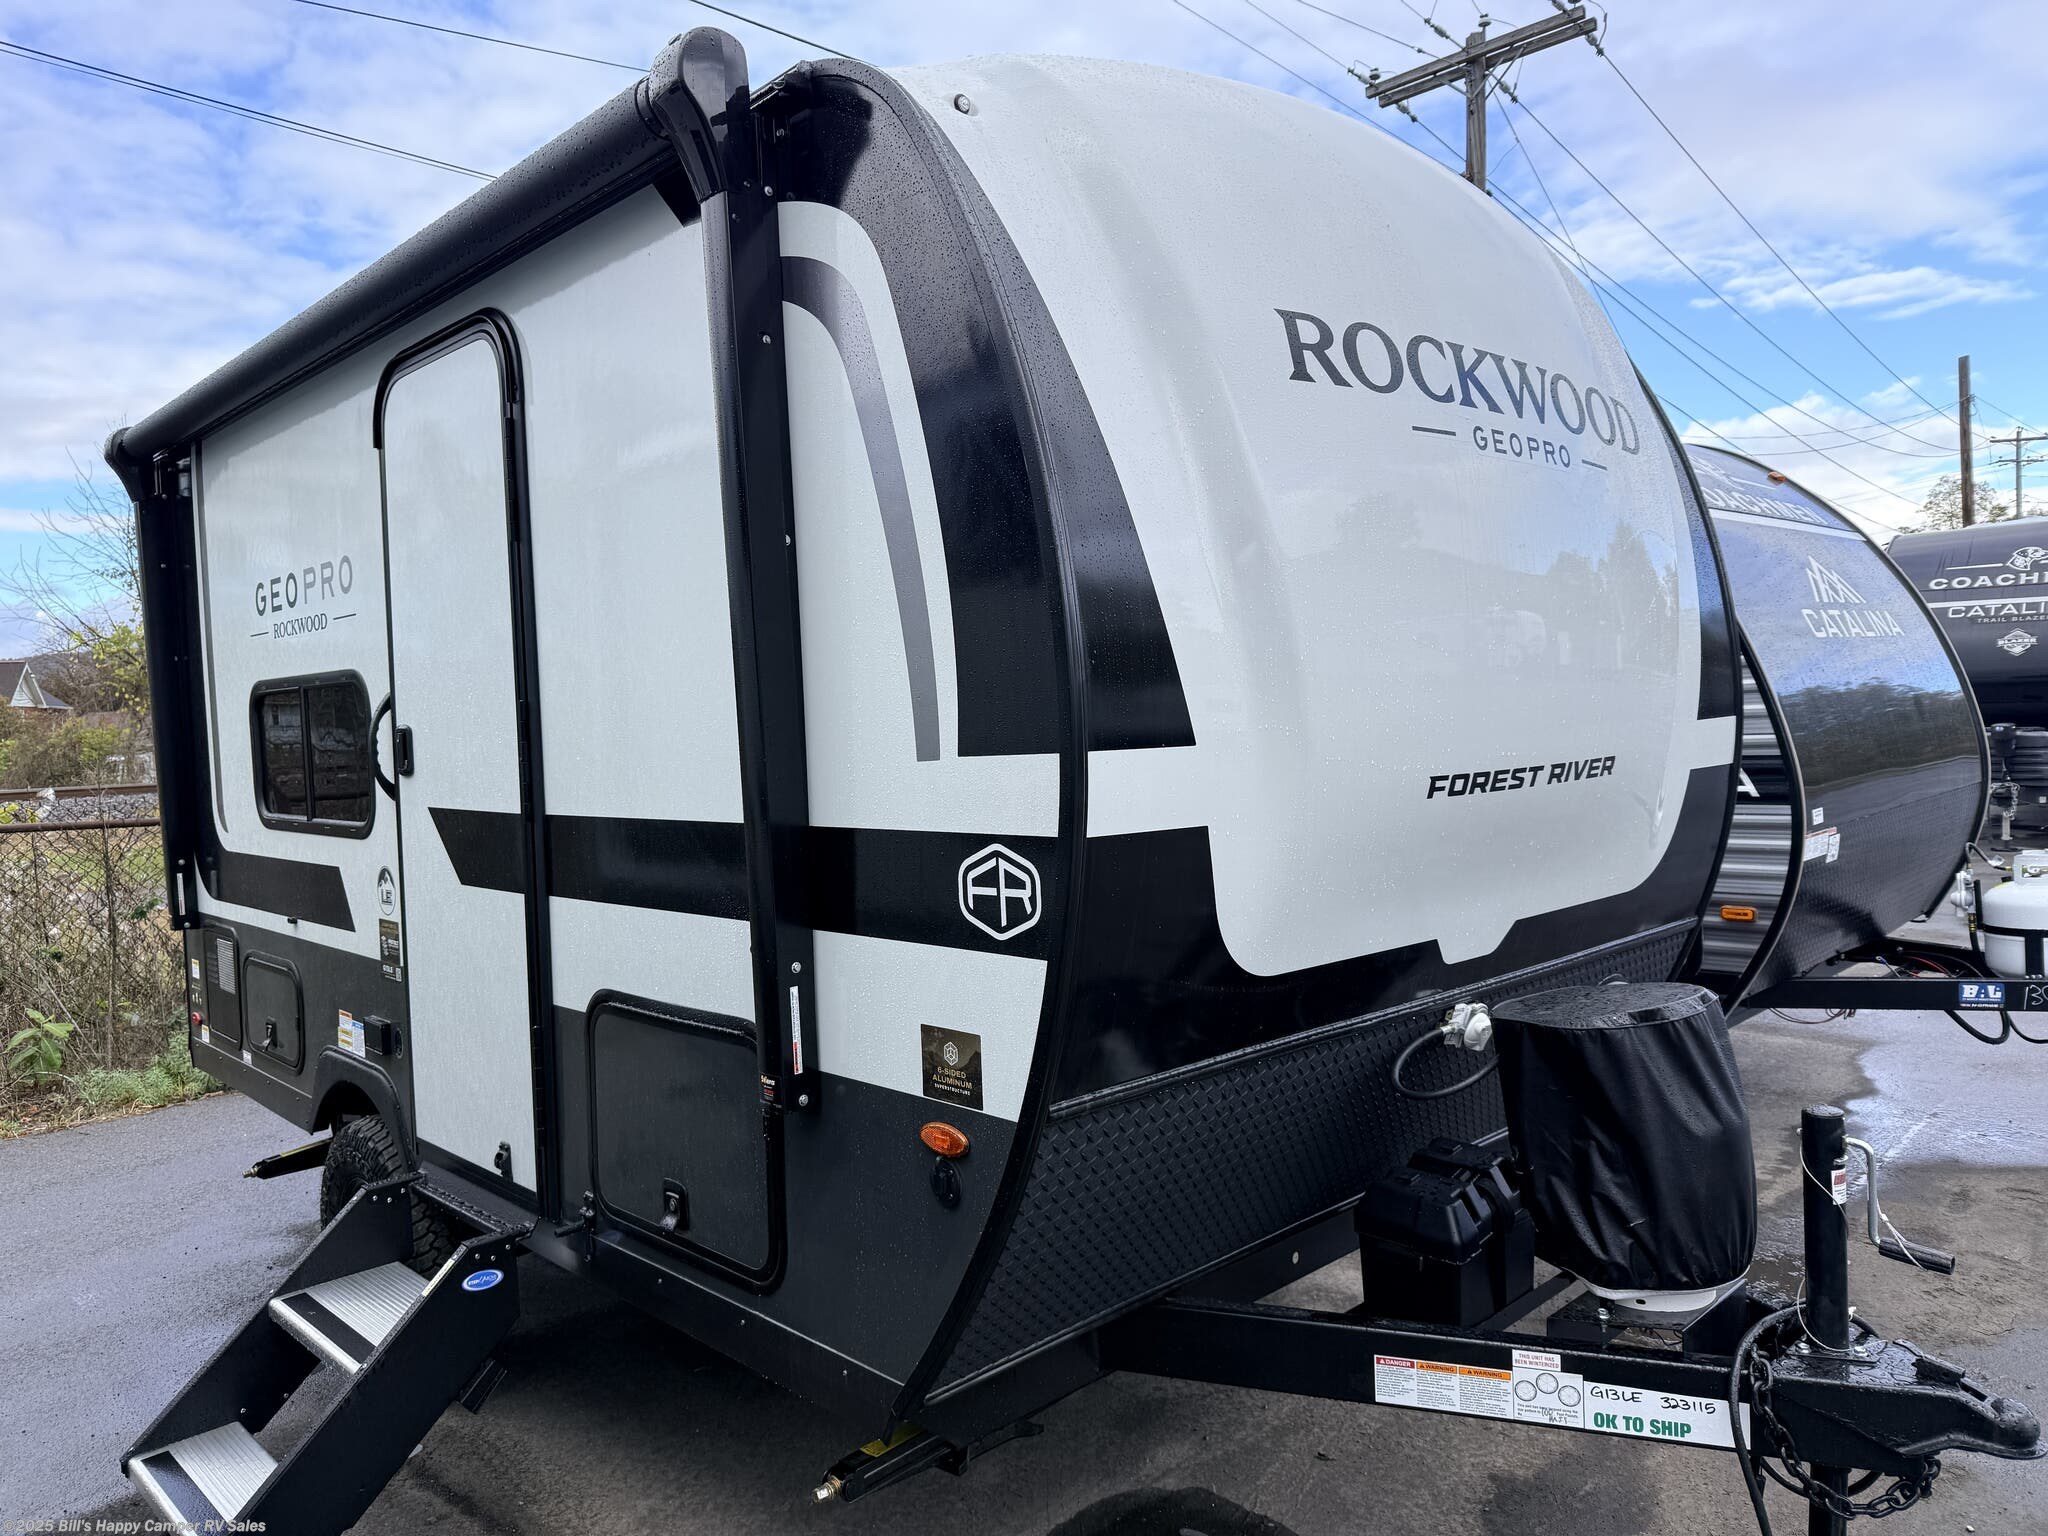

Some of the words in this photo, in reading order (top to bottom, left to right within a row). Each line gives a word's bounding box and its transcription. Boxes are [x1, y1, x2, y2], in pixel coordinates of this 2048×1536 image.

[1273, 307, 1640, 456] ROCKWOOD
[1473, 425, 1571, 469] GEOPRO
[1701, 486, 1829, 525] OACHMEN
[255, 555, 353, 616] GEOPRO
[273, 612, 328, 639] ROCKWOOD
[1801, 608, 1905, 638] CATALINA
[2011, 614, 2048, 622] BLAZE
[1426, 765, 1545, 799] FOREST
[1547, 756, 1616, 785] RIVER
[932, 1073, 973, 1090] ALUMINUM
[1385, 1359, 1411, 1367] DANGER
[1426, 1364, 1454, 1372] WARNING
[1472, 1370, 1503, 1378] WARNING
[1660, 1396, 1716, 1414] 323115
[1593, 1411, 1619, 1430] OK
[1622, 1415, 1644, 1433] TO
[1649, 1418, 1692, 1438] SHIP
